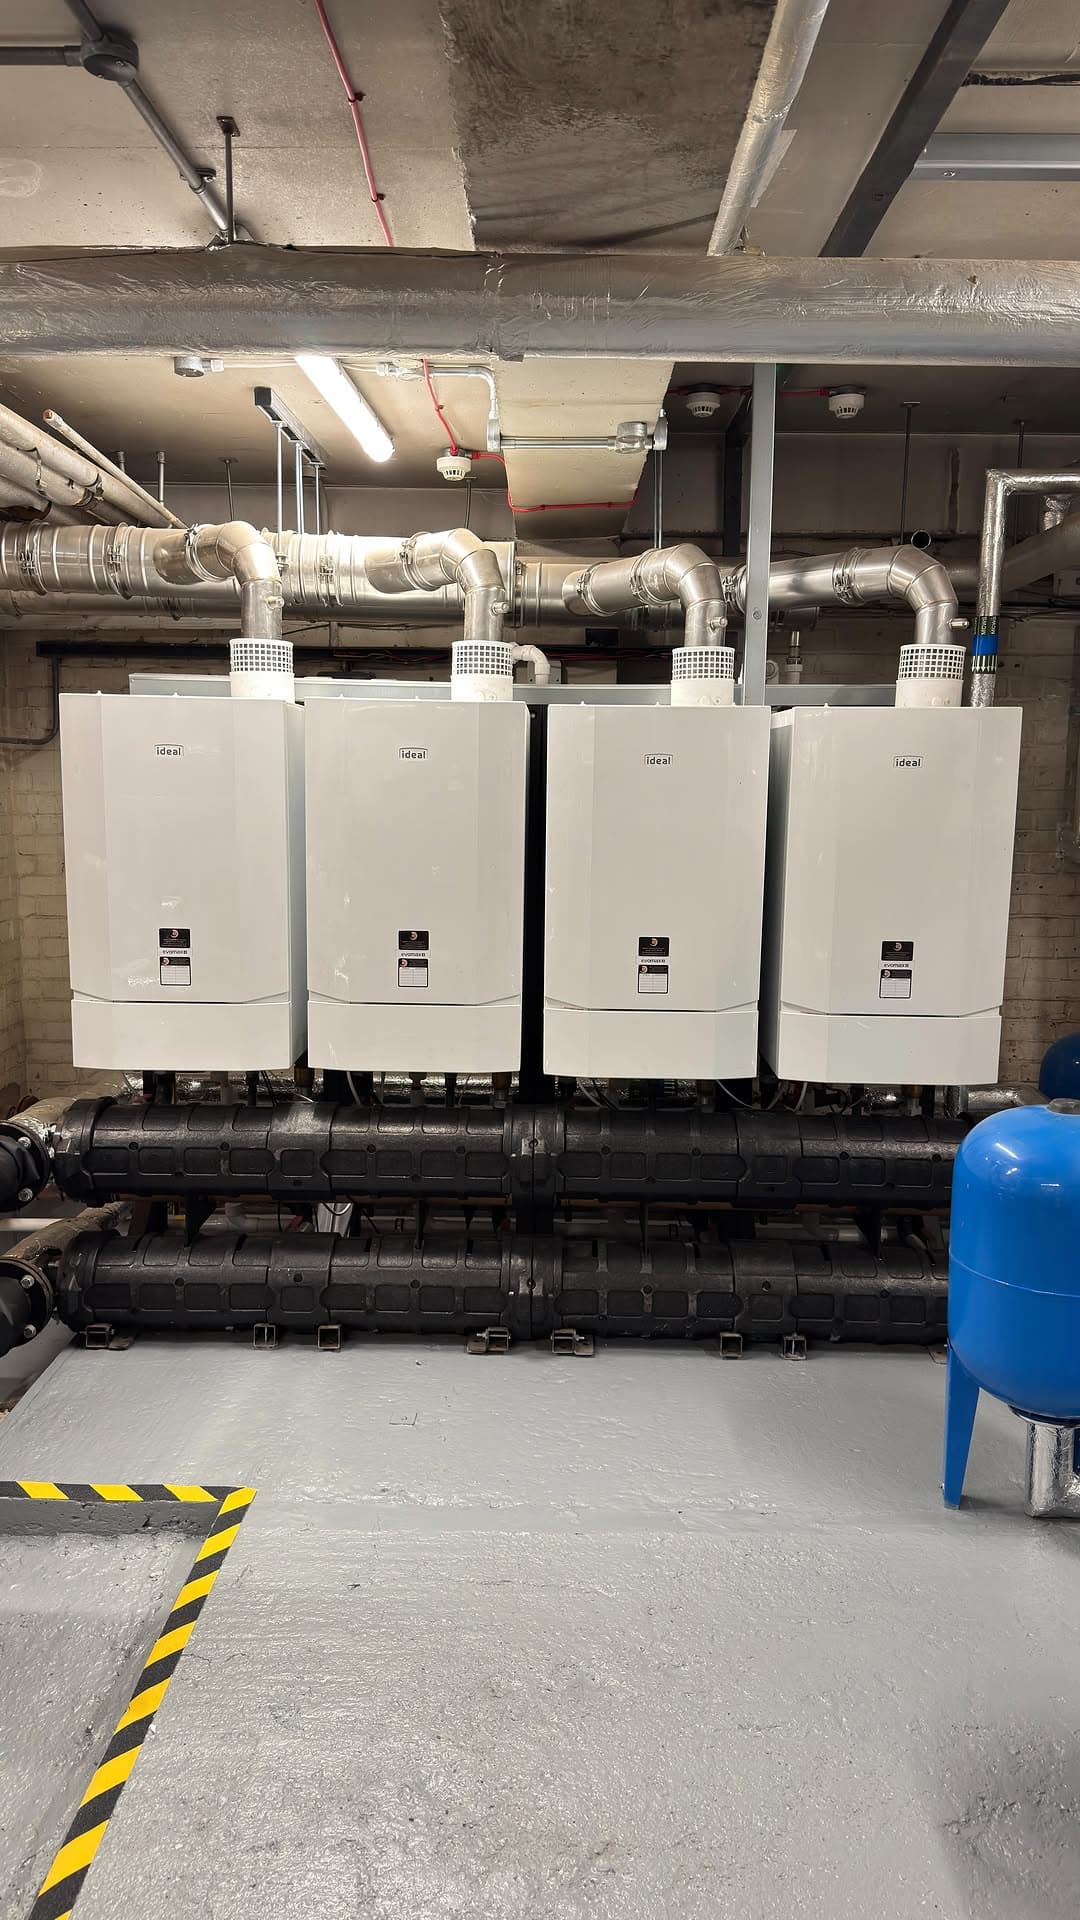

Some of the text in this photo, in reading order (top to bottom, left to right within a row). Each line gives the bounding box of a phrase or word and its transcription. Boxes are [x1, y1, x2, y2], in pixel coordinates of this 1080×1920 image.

[156, 747, 181, 756] ideal
[401, 750, 426, 759] ideal
[646, 756, 671, 765] ideal
[895, 758, 921, 767] ideal
